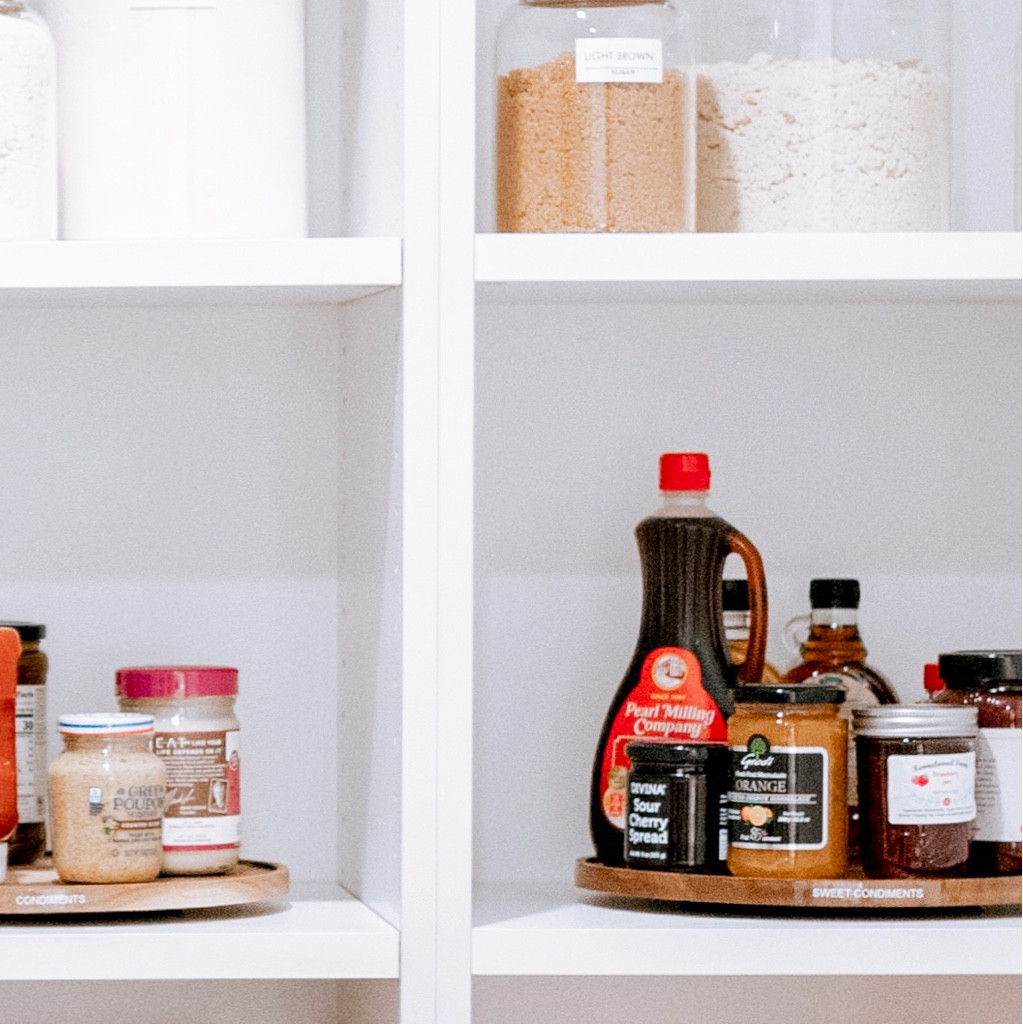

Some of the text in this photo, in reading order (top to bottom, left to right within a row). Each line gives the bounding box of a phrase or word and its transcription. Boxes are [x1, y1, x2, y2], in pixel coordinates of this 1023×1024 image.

[584, 51, 654, 61] LIGHT BROWN
[625, 701, 716, 726] Pearl Milling
[633, 718, 703, 738] Company
[630, 781, 666, 796] DIVINA
[735, 779, 786, 793] ORANGE
[633, 797, 662, 814] Sour
[629, 813, 669, 832] Cherry
[629, 828, 668, 845] Spread
[15, 894, 87, 906] CONDIMENTS
[811, 887, 925, 899] SWEET CONDIMENTS
